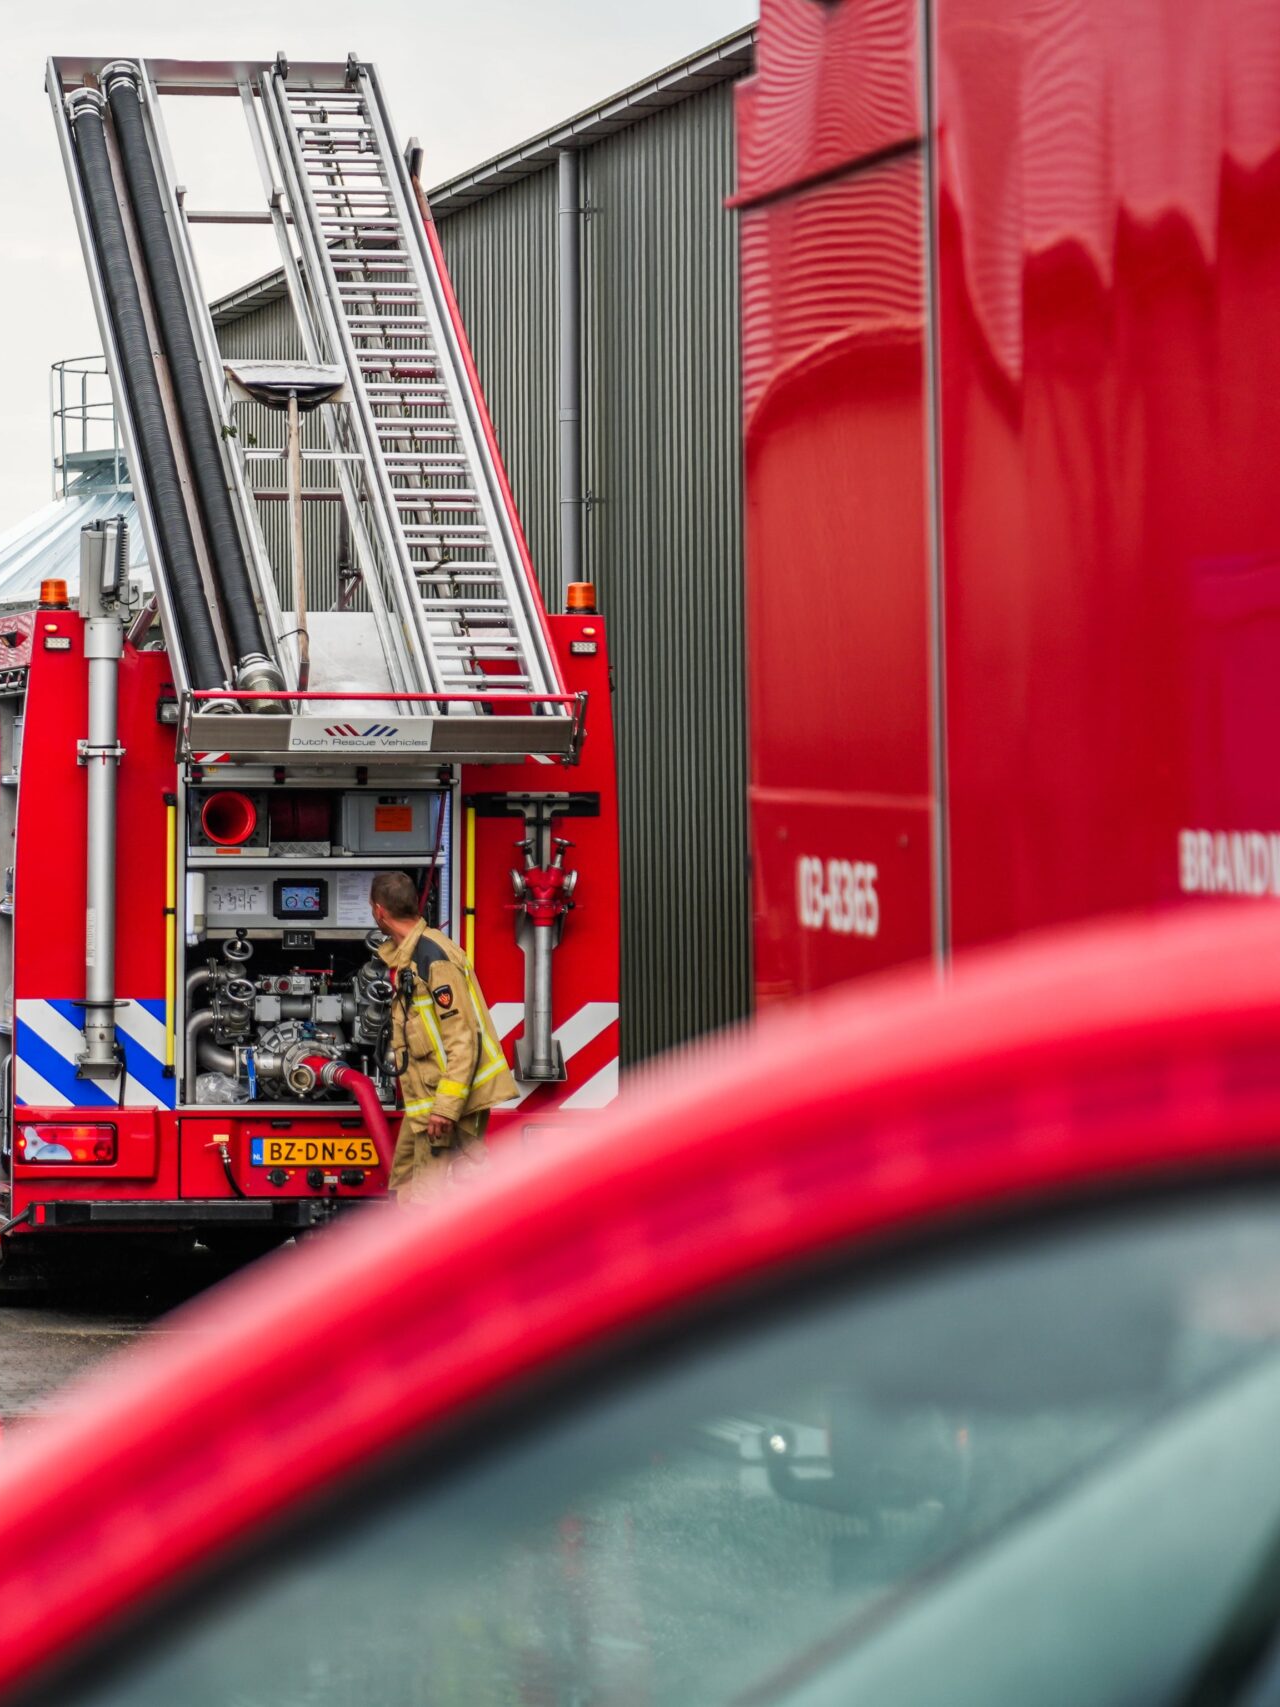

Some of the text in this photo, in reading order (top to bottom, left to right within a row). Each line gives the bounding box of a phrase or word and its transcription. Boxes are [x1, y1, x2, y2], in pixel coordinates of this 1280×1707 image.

[292, 738, 428, 746] Dutch Rescue Vehicles
[270, 1142, 373, 1161] BZ-DN-65
